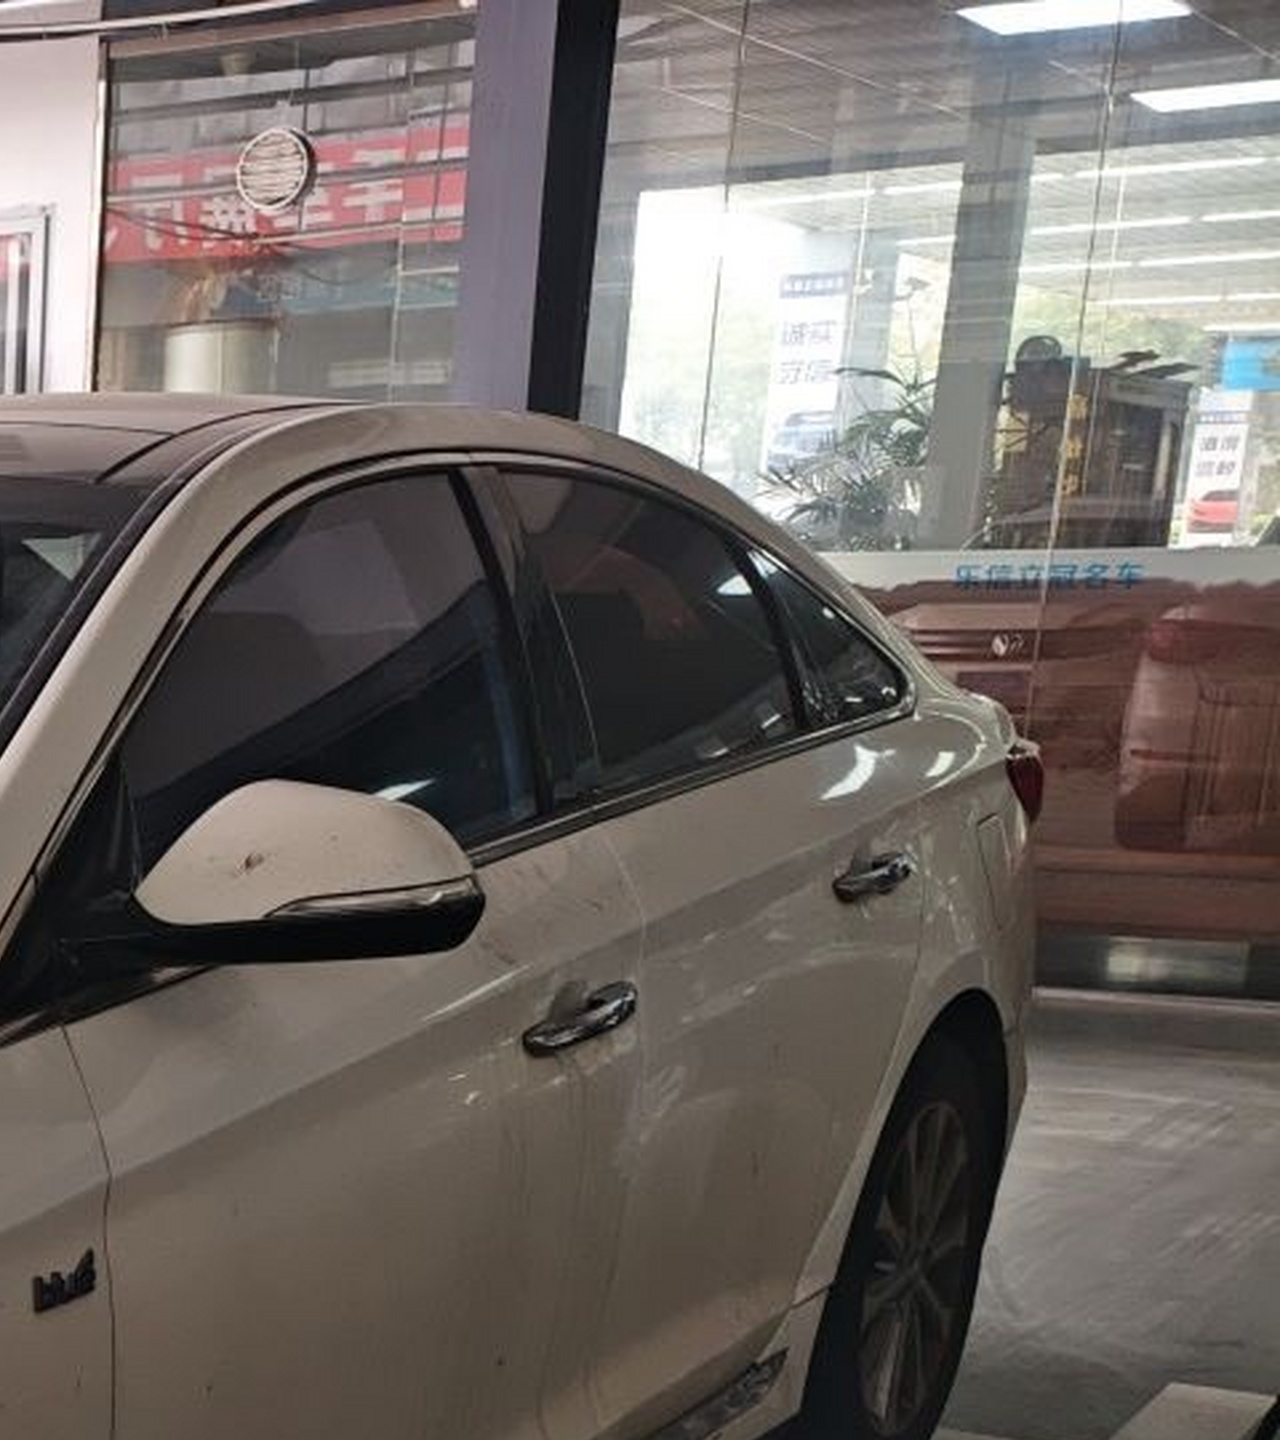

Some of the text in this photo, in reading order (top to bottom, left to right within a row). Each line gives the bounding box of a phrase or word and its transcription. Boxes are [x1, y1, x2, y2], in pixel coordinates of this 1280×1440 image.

[955, 561, 1144, 591] 乐信立冠名车
